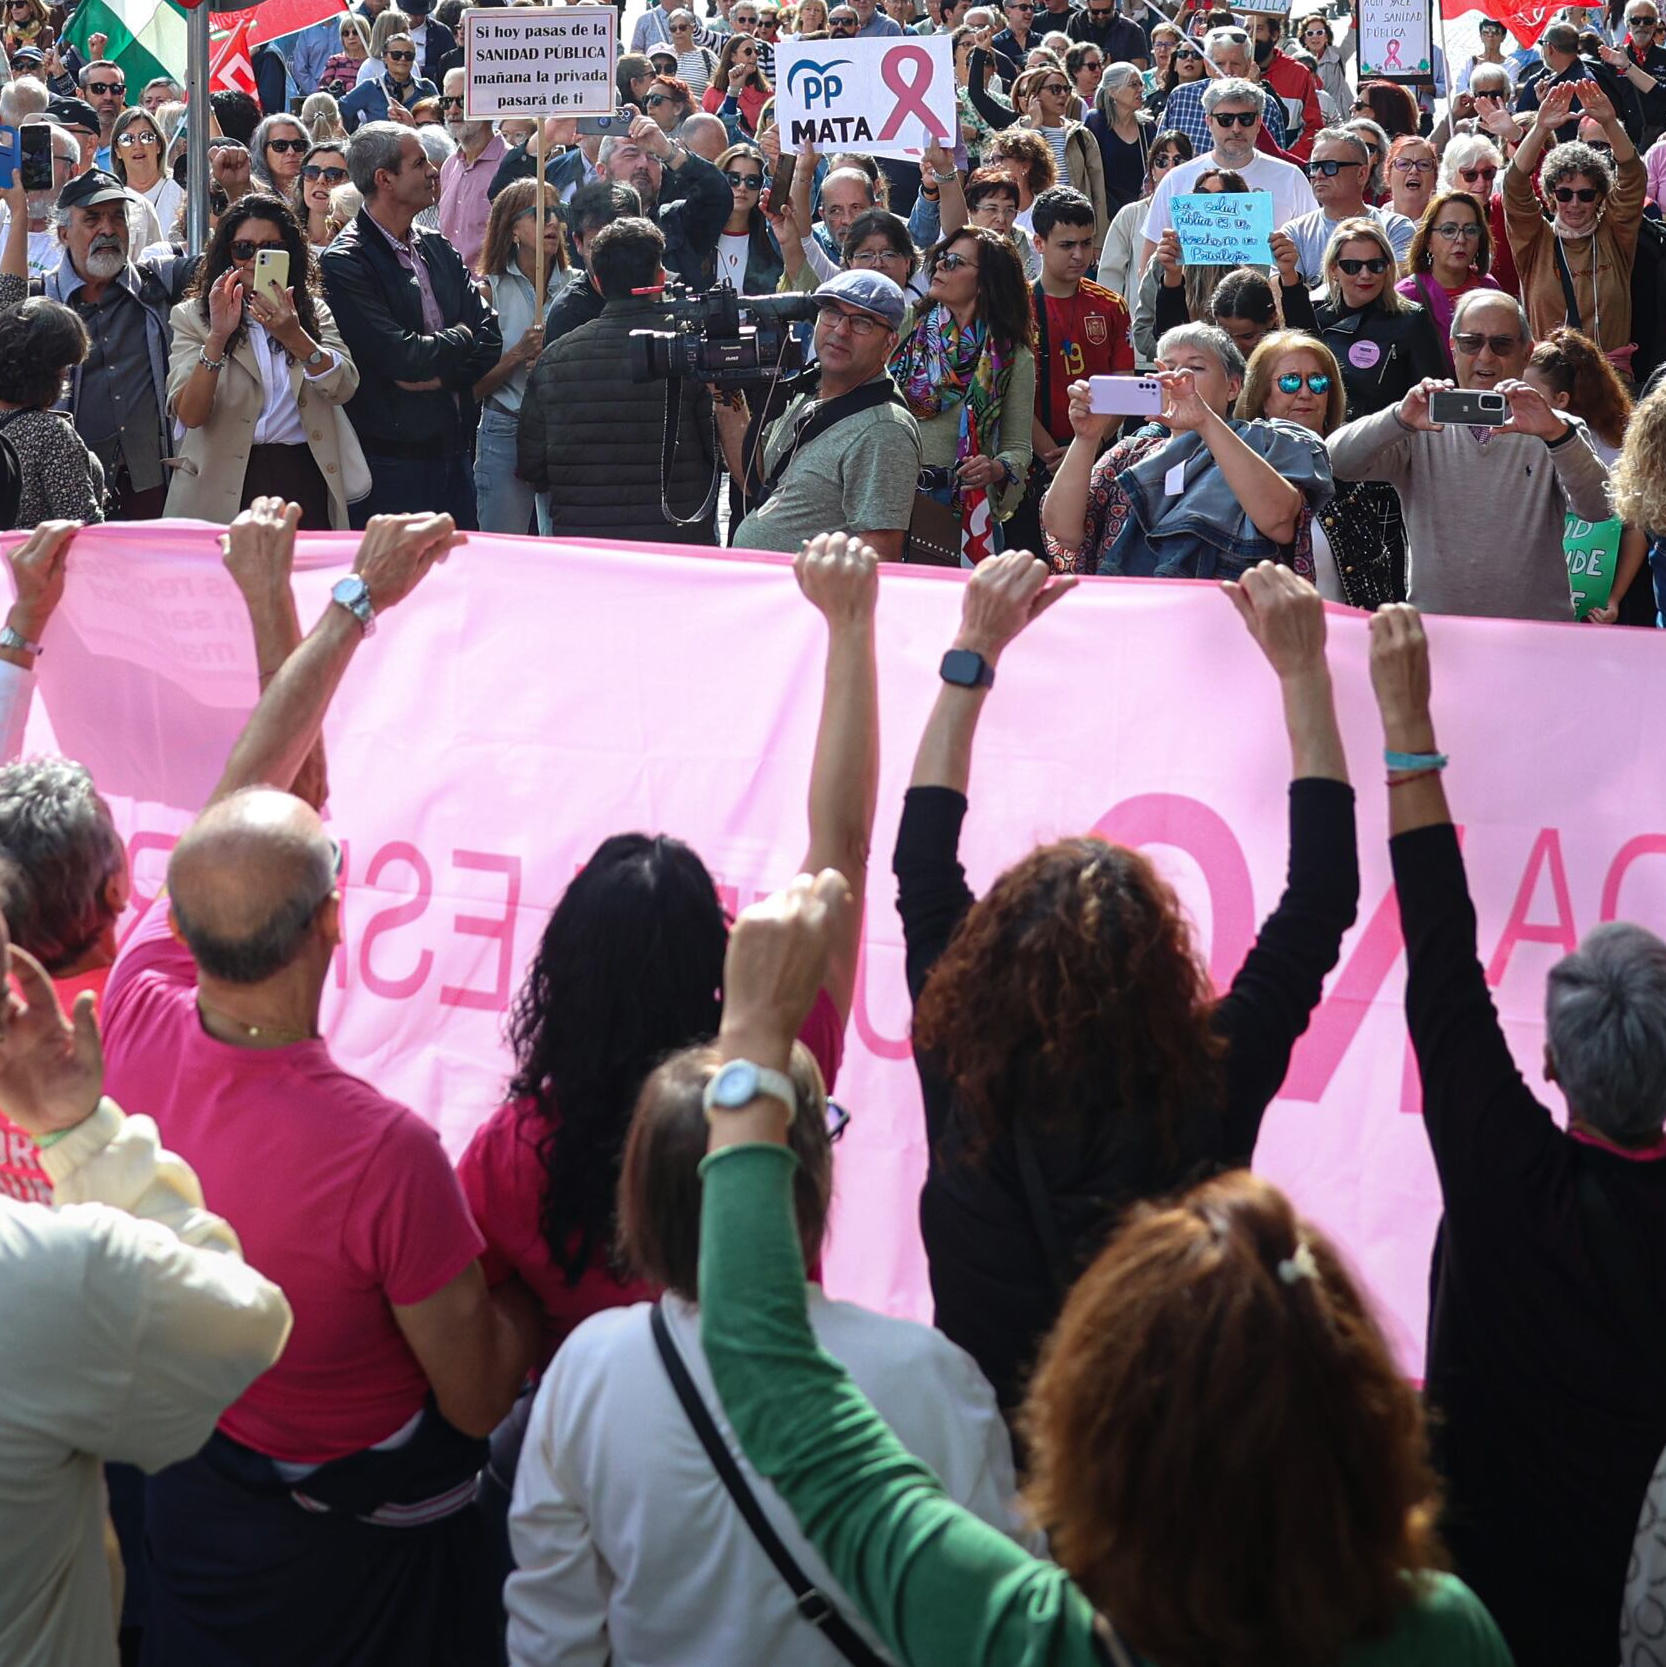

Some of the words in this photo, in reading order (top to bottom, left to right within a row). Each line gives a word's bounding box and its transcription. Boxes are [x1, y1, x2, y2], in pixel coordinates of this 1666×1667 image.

[476, 26, 489, 38] Si
[494, 26, 520, 40] hoy
[525, 26, 567, 38] pasas
[571, 24, 589, 36] de
[593, 23, 606, 36] la
[476, 48, 539, 62] SANIDAD
[545, 44, 606, 60] PÚBLICA
[474, 72, 531, 84] mañana
[536, 71, 549, 83] la
[554, 69, 608, 84] privada
[497, 93, 547, 109] pasará
[552, 92, 568, 105] de
[573, 92, 583, 104] ti
[803, 75, 843, 111] PP
[791, 116, 873, 145] MATA
[1203, 195, 1241, 216] salud
[1059, 342, 1084, 376] 19
